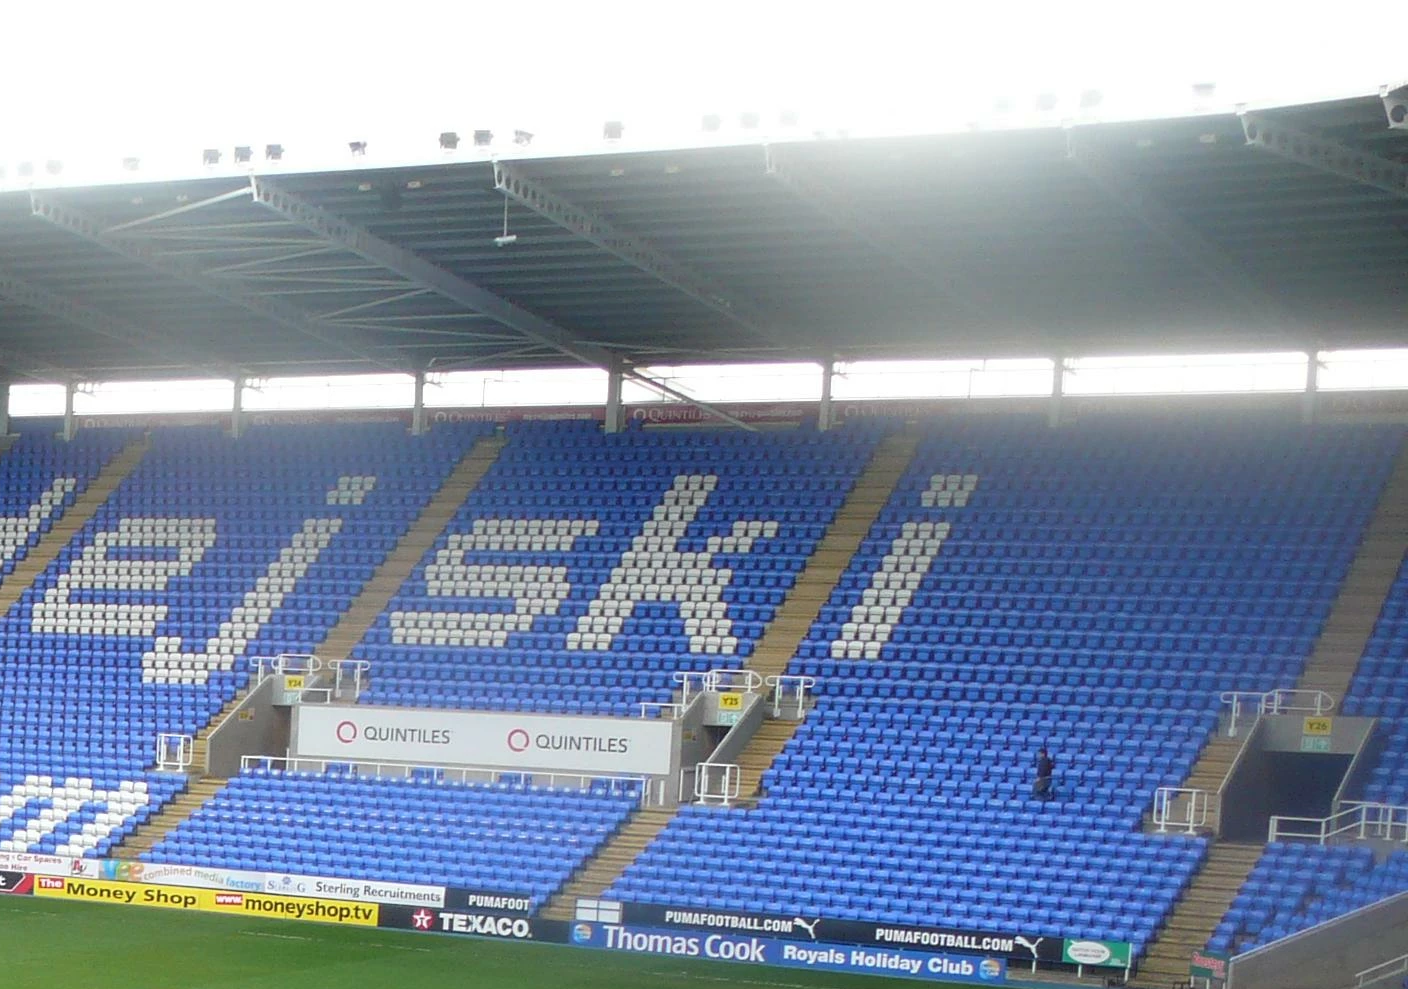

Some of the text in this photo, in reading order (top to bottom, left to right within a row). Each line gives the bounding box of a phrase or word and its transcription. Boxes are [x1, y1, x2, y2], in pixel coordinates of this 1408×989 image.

[364, 725, 452, 746] QUINTILES
[535, 733, 629, 754] QUINTILES
[143, 867, 193, 881] combined
[194, 870, 224, 885] media
[225, 878, 262, 891] factory
[40, 878, 197, 908] The Money Shop
[315, 881, 360, 898] Sterling
[364, 885, 441, 903] Recruitments
[468, 895, 530, 911] PUMAFOOT
[245, 897, 373, 922] moneyshop.tv
[665, 910, 793, 933] PUMAFOOTBALL.COM
[439, 912, 529, 938] TEXACO
[602, 925, 765, 962] Thomas Cook
[875, 928, 1014, 952] PUMAFOOTBALL.COM
[783, 945, 973, 976] Royals Holiday Club
